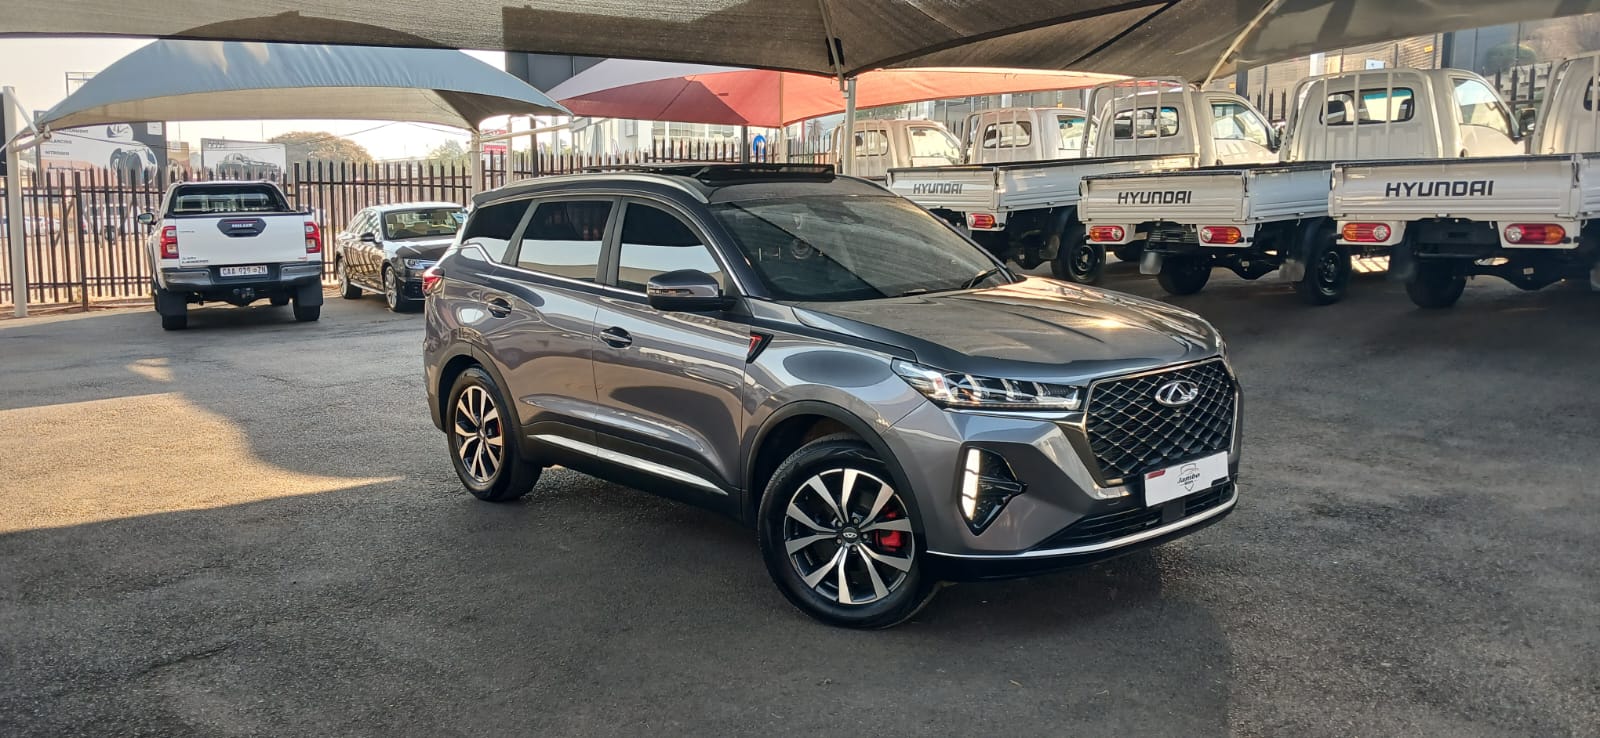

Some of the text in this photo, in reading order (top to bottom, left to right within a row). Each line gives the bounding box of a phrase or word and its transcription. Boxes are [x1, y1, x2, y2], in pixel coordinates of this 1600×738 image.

[913, 183, 963, 195] HYUNDAI
[1385, 180, 1494, 197] HYUNDAI
[1117, 190, 1192, 205] HYUNDAI
